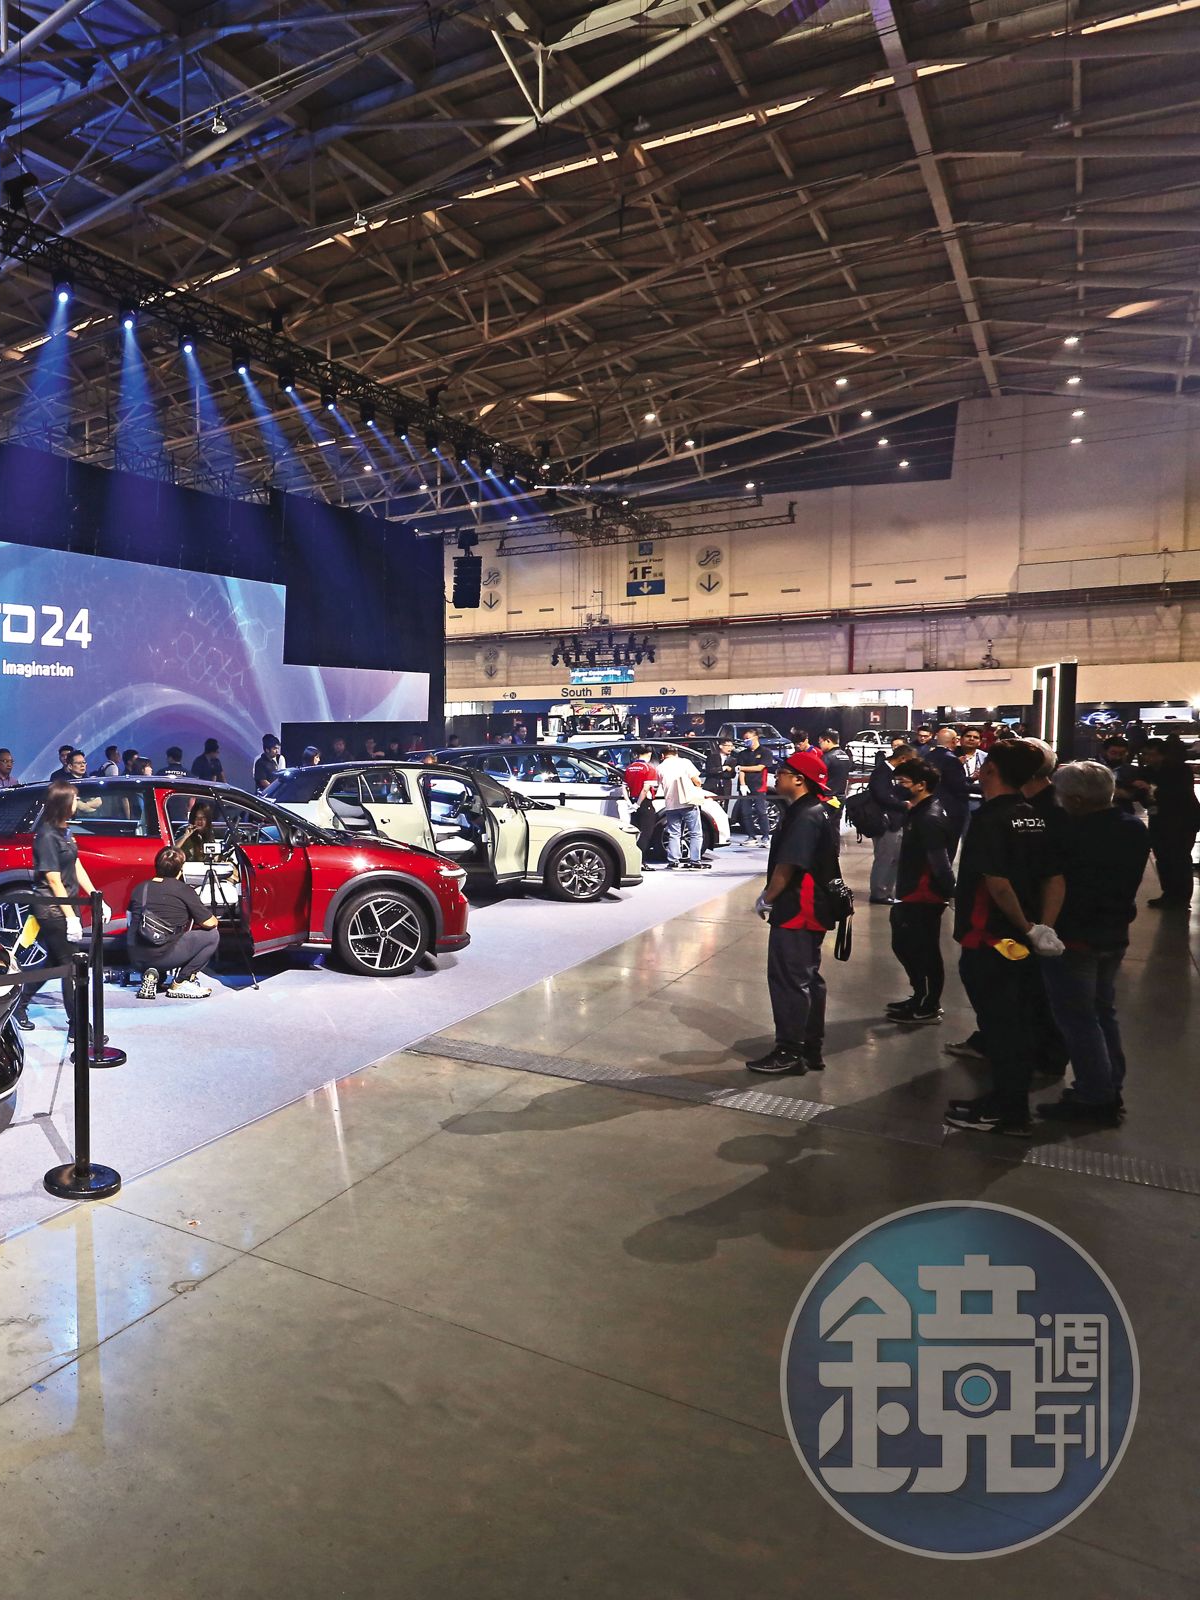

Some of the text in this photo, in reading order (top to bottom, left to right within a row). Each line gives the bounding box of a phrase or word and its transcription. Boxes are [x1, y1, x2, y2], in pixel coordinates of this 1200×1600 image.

[629, 566, 652, 580] 1F
[2, 659, 74, 678] Imagination
[561, 687, 592, 698] South
[601, 686, 612, 696] 南
